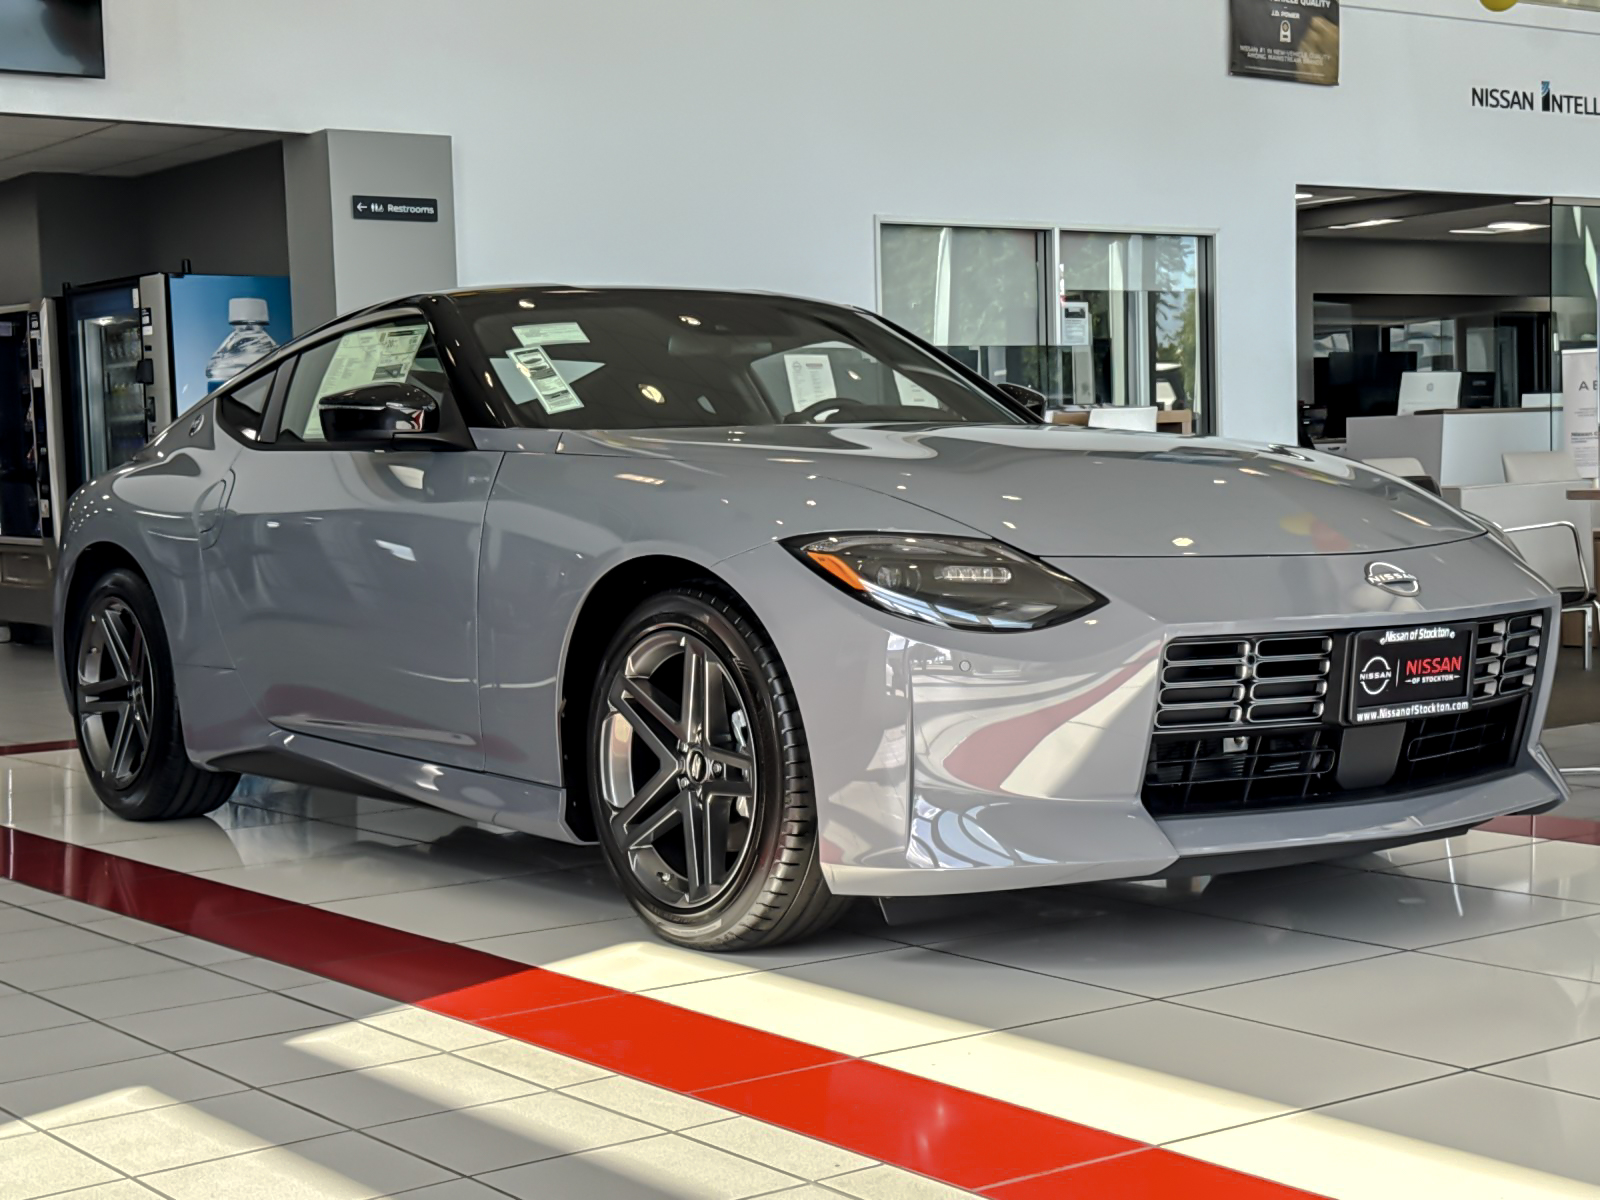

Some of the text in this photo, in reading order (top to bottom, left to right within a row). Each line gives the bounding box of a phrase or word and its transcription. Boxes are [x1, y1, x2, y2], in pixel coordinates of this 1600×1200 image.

[1472, 87, 1534, 111] NISSAN
[387, 204, 434, 214] Restrooms
[1385, 627, 1450, 643] Nissan of Stockton
[1406, 656, 1462, 676] NISSAN
[1360, 671, 1391, 680] NISSAN
[1421, 674, 1454, 683] STOCKTON
[1357, 701, 1469, 722] www.NissanofStockton.com
